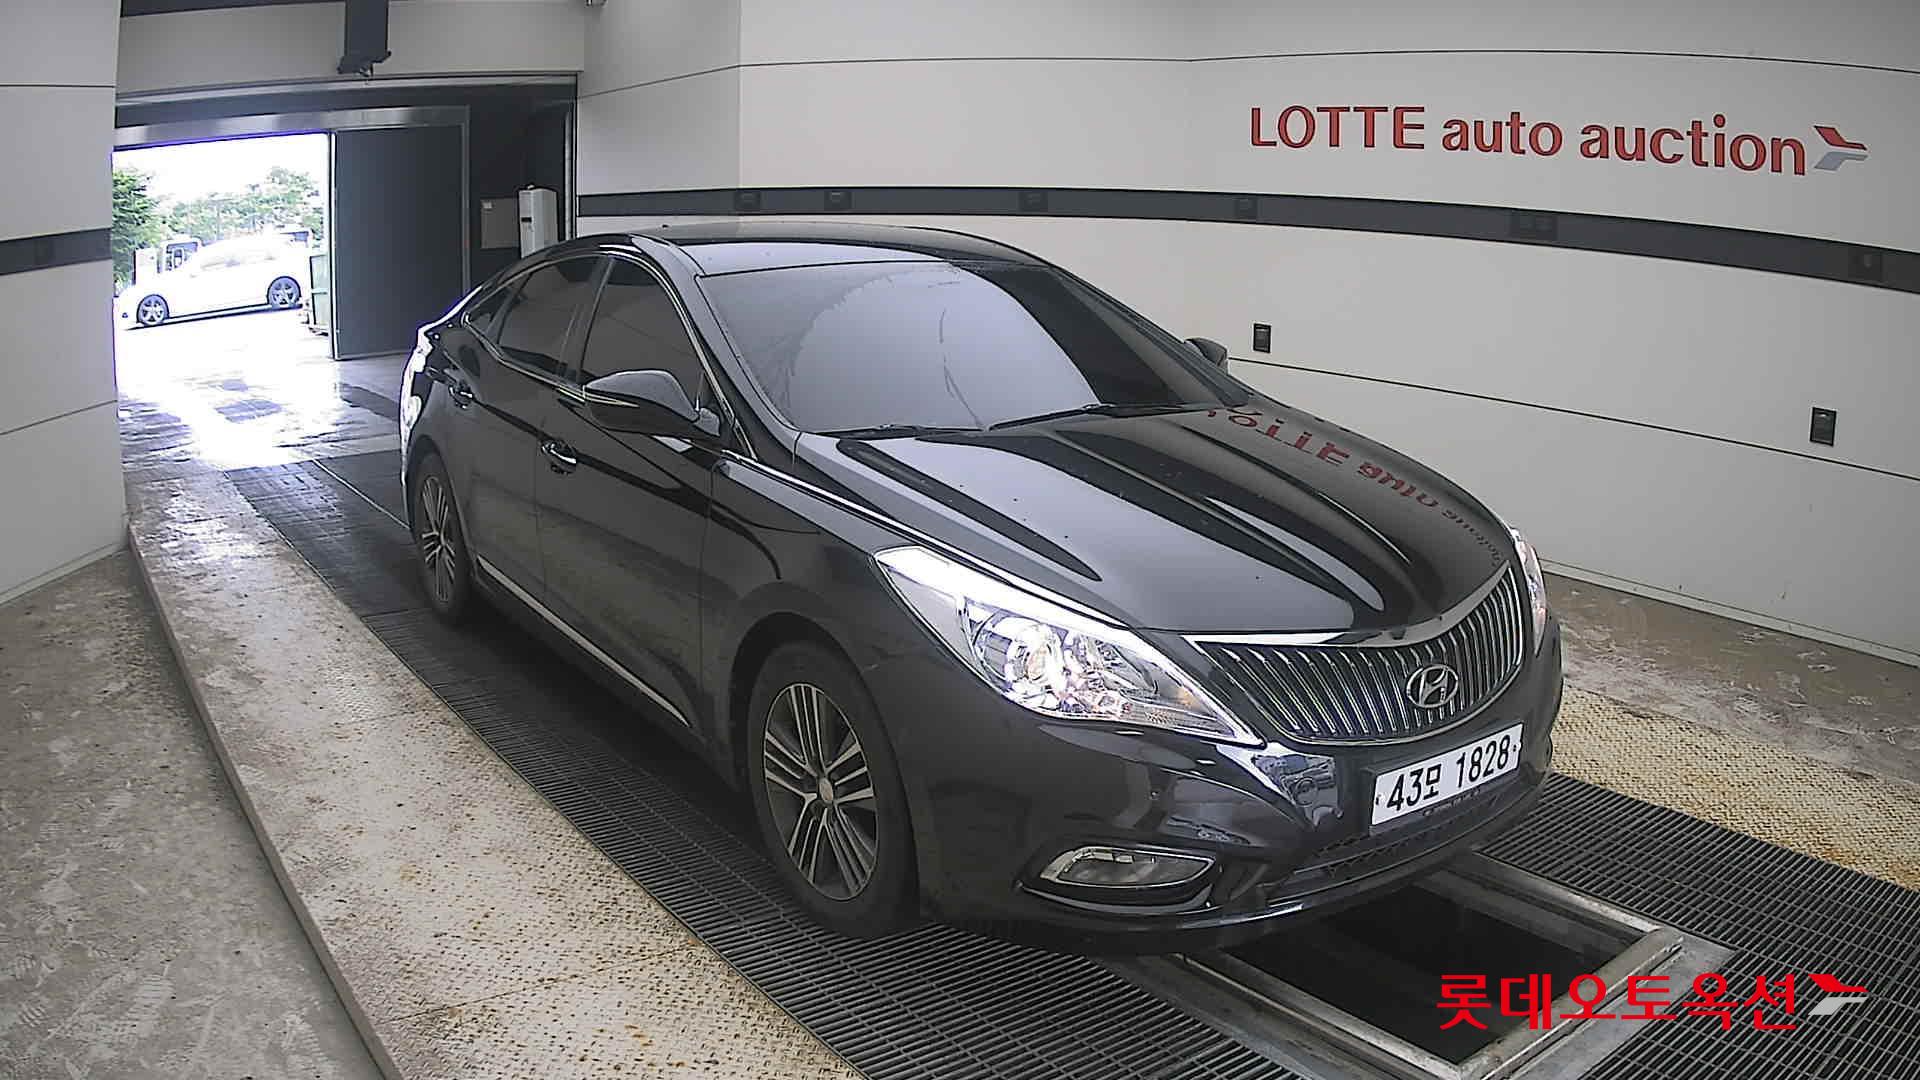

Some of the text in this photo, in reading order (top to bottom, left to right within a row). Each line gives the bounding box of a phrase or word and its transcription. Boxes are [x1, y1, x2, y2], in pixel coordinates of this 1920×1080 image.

[1250, 105, 1806, 176] LOTTE auto auction
[1386, 734, 1511, 812] 43모 1828
